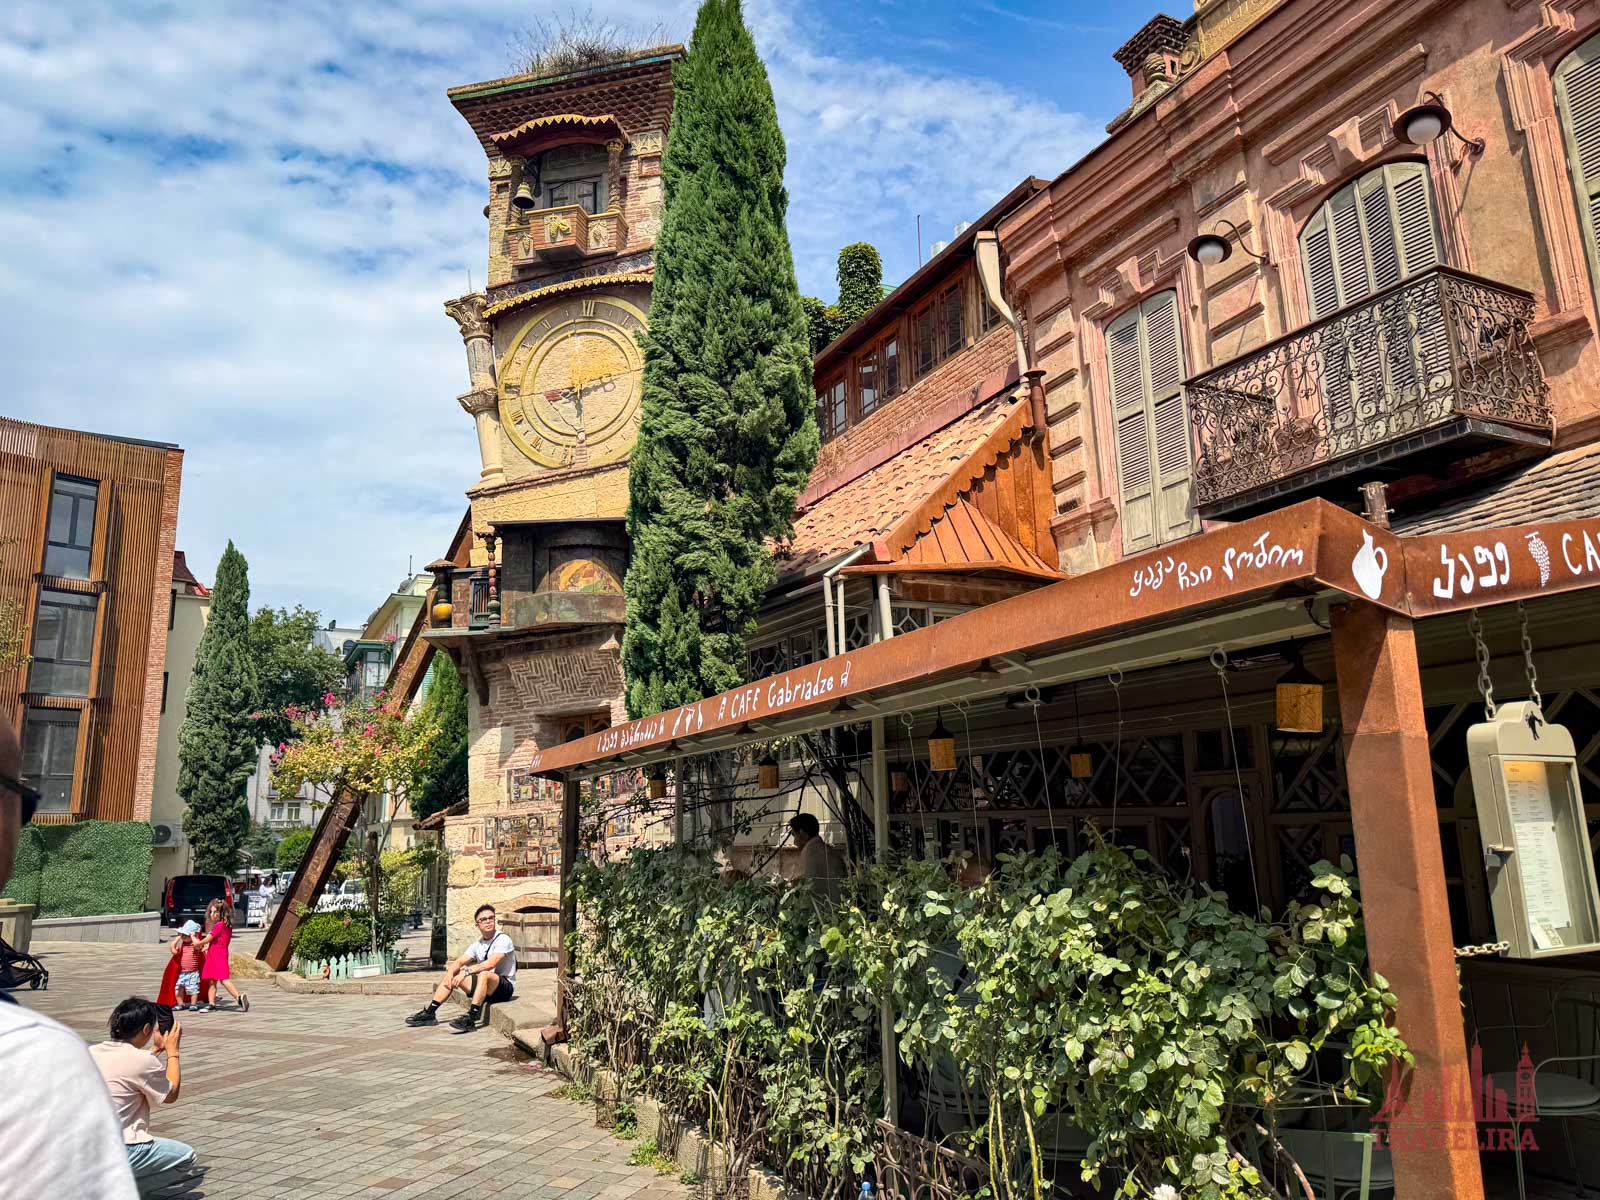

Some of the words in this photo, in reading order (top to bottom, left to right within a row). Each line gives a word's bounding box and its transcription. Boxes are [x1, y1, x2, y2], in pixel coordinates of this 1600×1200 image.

[580, 299, 596, 317] XII
[1562, 529, 1600, 575] CA
[1129, 556, 1175, 597] ყავა
[1177, 561, 1212, 591] ჩაი
[731, 687, 761, 719] CAFE
[768, 667, 834, 709] Gabriadze
